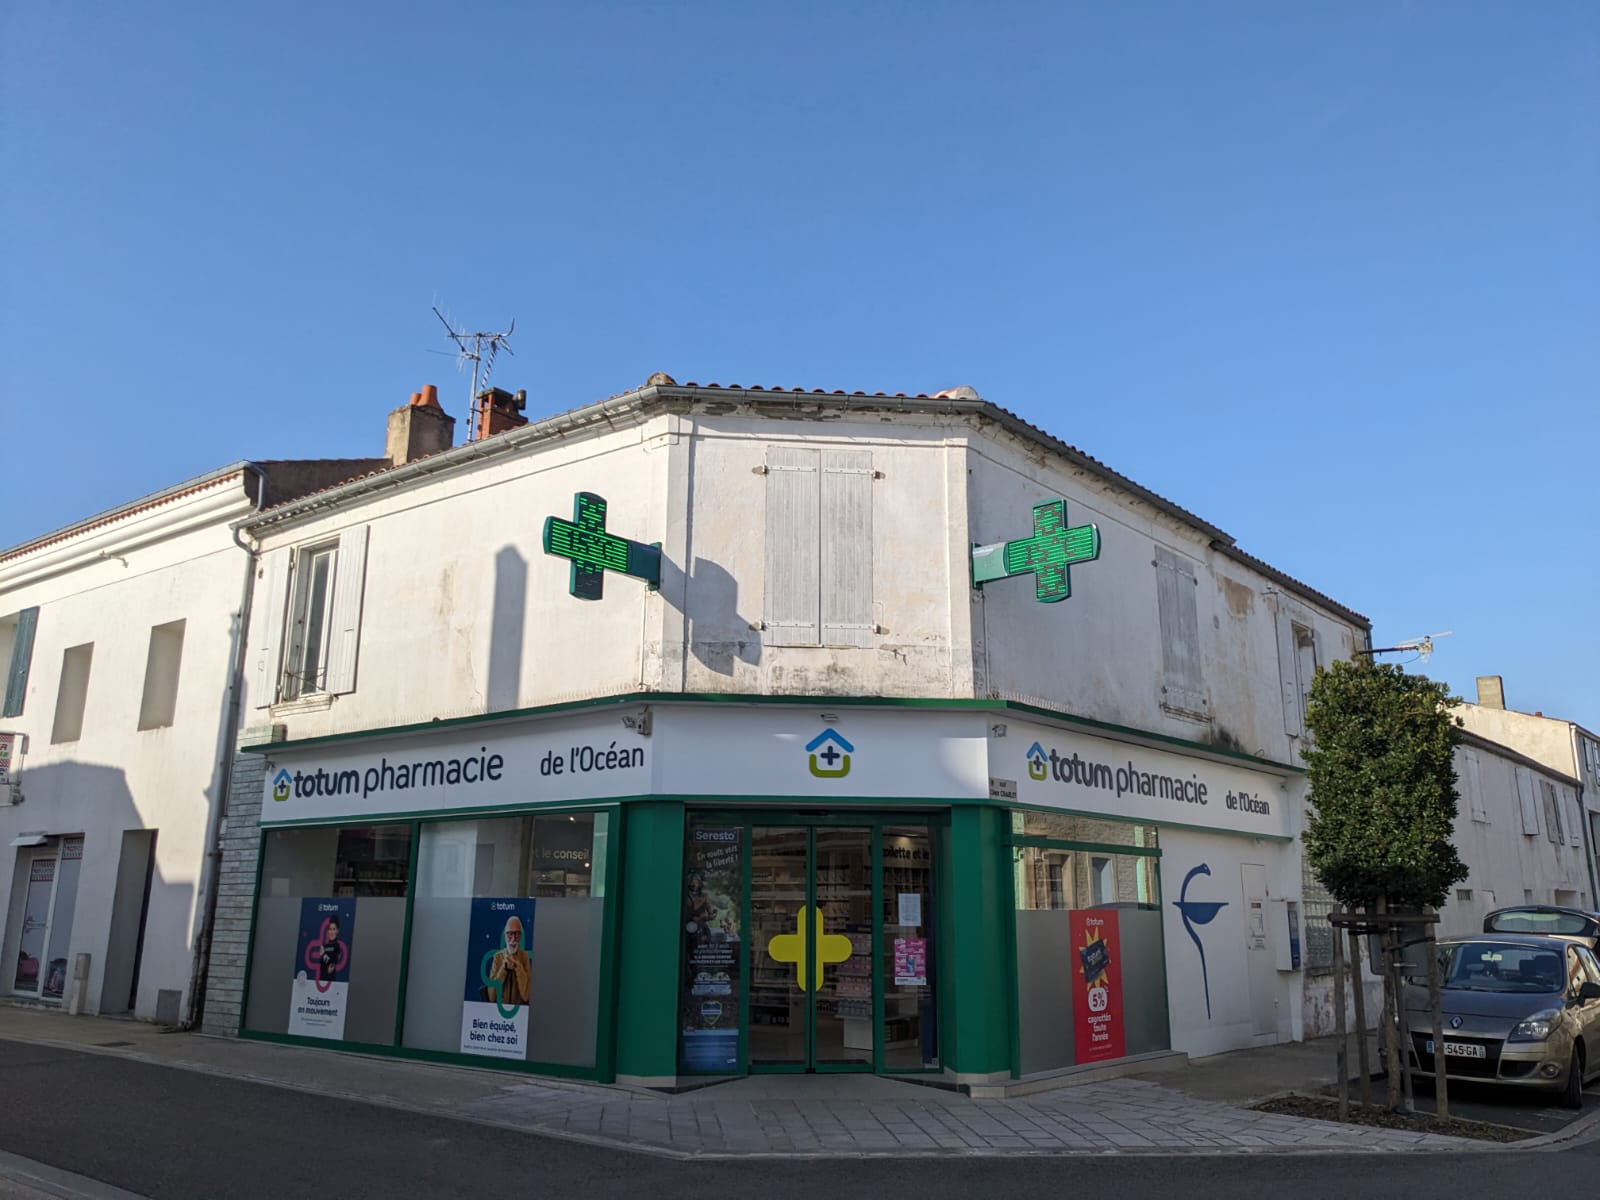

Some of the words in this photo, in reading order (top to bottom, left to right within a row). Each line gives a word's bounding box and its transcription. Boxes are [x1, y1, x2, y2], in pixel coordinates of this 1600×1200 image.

[540, 750, 563, 777] de
[570, 741, 645, 774] l'Océan
[293, 764, 360, 799] totum
[363, 746, 504, 799] pharmacie
[1050, 748, 1114, 790] totum
[1116, 761, 1208, 806] pharmacie
[1225, 790, 1238, 810] de
[1239, 792, 1270, 816] l'Océan
[695, 831, 735, 841] Seresto
[553, 848, 590, 860] conseil
[496, 902, 515, 911] totum
[1092, 991, 1105, 1007] 5%
[472, 1018, 488, 1029] Bien
[489, 1020, 517, 1033] équipé,
[469, 1030, 486, 1041] bien
[487, 1033, 505, 1044] chez
[506, 1035, 518, 1045] soi
[1445, 1044, 1478, 1057] -545-GA
